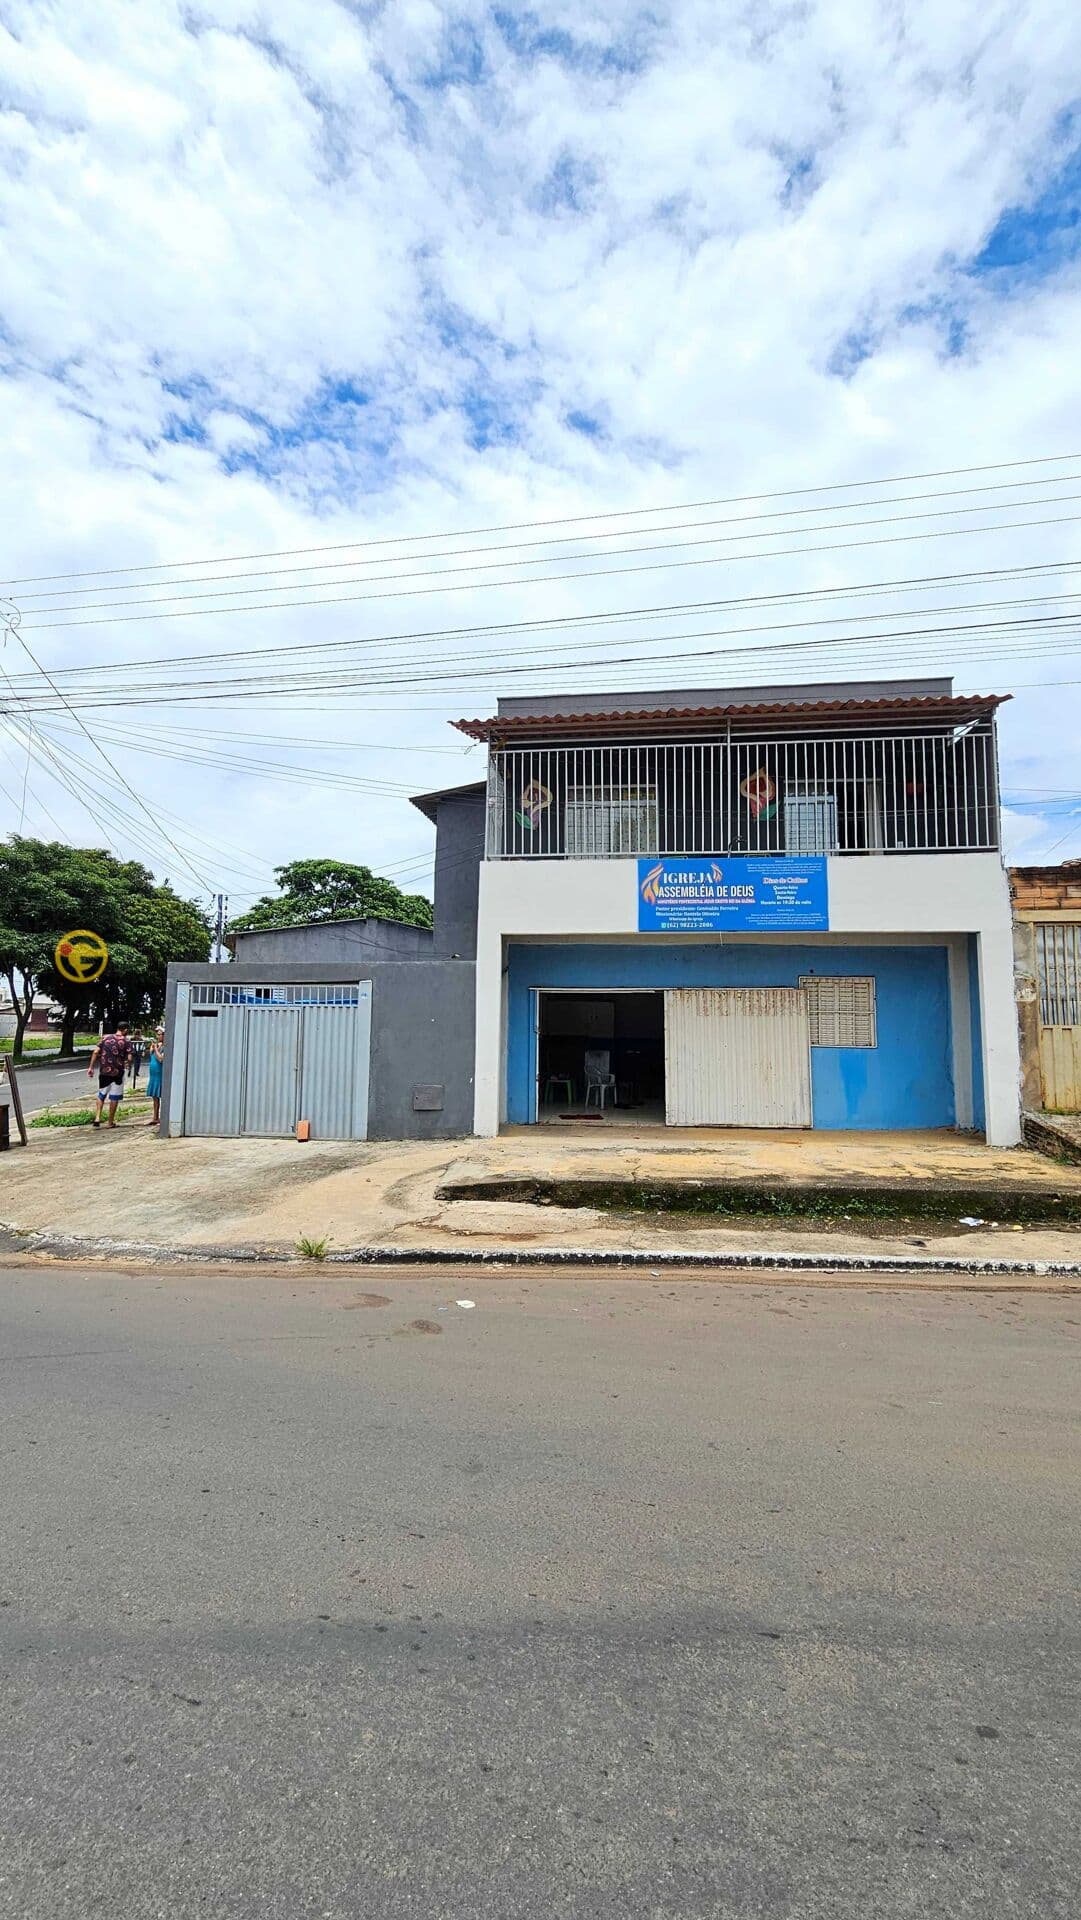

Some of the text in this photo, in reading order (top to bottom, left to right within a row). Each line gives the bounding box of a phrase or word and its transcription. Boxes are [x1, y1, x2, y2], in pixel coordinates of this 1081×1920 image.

[663, 872, 714, 884] IGREJA
[658, 884, 754, 898] ASSEMBLÉIA DE DEUS
